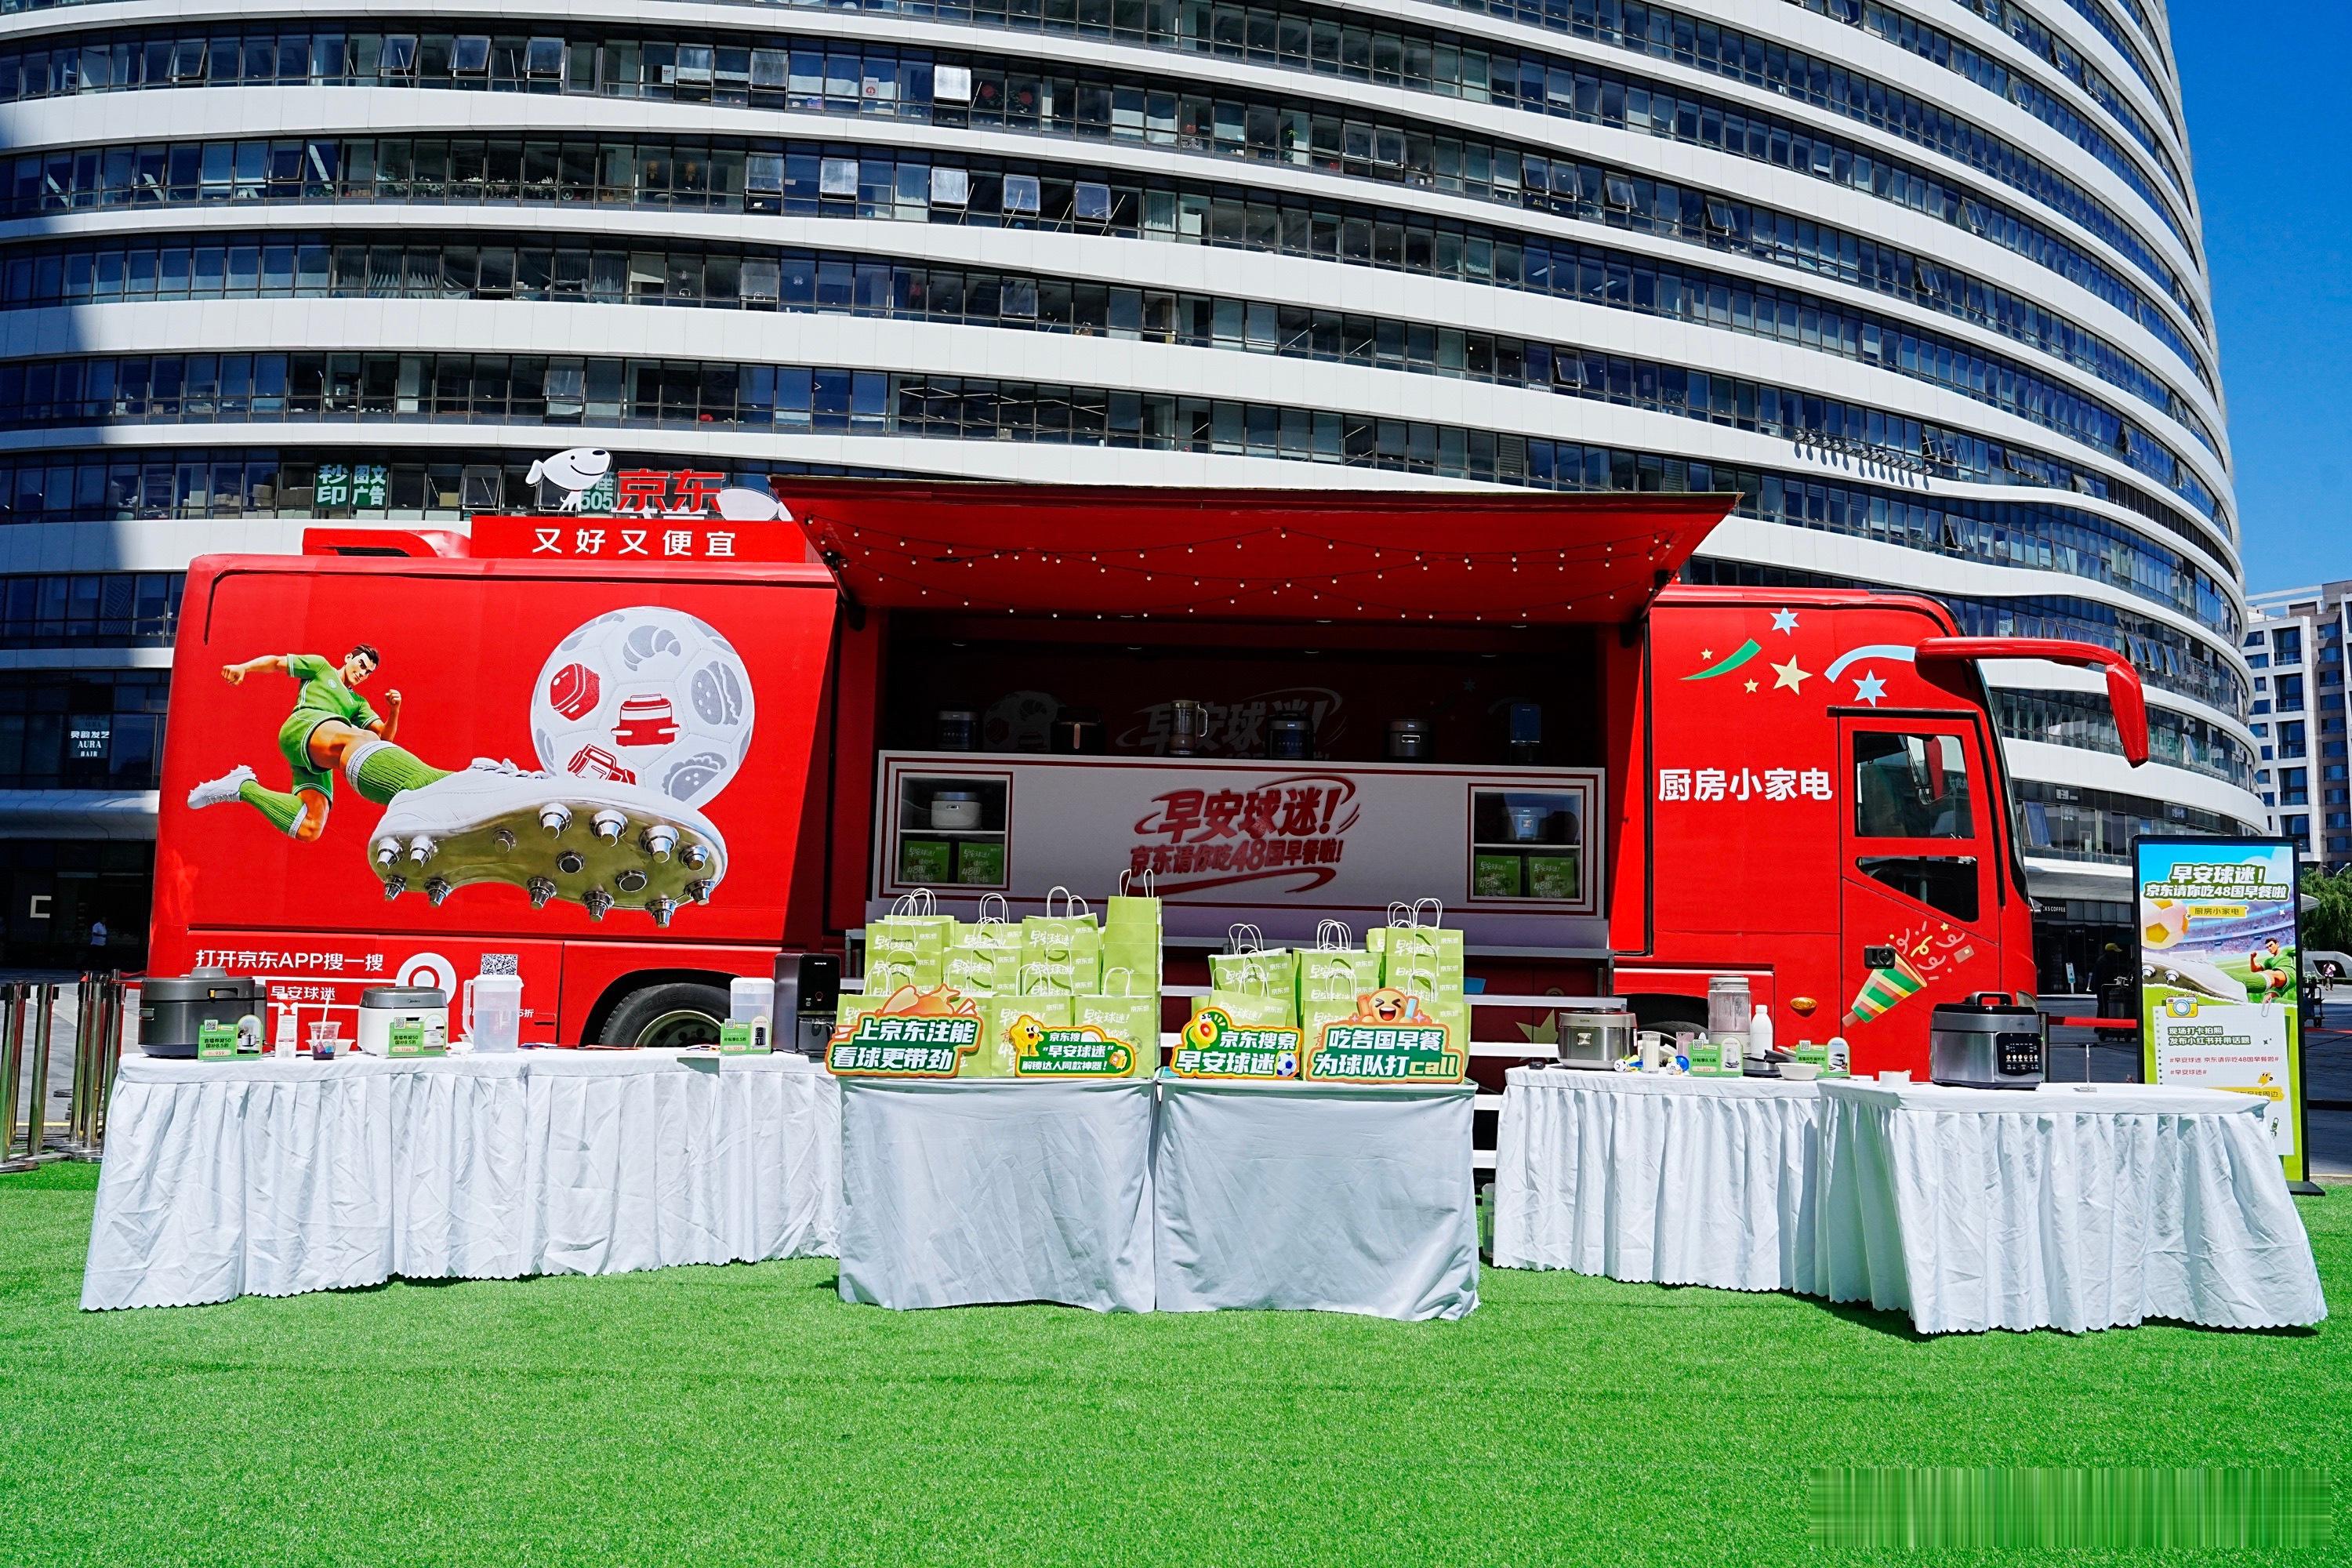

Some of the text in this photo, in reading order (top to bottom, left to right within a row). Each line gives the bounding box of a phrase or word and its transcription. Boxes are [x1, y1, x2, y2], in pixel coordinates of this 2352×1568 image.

[353, 464, 387, 485] 图文
[352, 485, 386, 506] 广告
[581, 492, 613, 510] 505
[616, 468, 726, 514] 京东
[532, 528, 735, 557] 又好又便宜
[77, 740, 102, 749] AURA
[1657, 768, 1834, 801] 厨房小家电
[1151, 787, 1342, 844] 早安球迷!
[1129, 839, 1344, 878] 京东请你吃48国早餐啦!
[2171, 865, 2264, 884] 早安球迷!
[2146, 884, 2286, 898] 京东请你吃48国早餐啦
[2194, 907, 2240, 916] 厨房小家电
[195, 949, 384, 972] 打开京东APP搜一搜
[270, 985, 336, 1000] 早安球迷
[855, 1019, 976, 1044] 上京东注能
[1049, 1033, 1081, 1042] 京东搜
[1220, 1030, 1298, 1051] 京东搜索
[1328, 1029, 1443, 1051] 吃各国早餐
[2168, 1026, 2223, 1036] 现场打卡拍照
[2169, 1036, 2251, 1046] 发布小红书并带话题
[833, 1046, 954, 1070] 看球更带劲
[1022, 1060, 1108, 1071] 解锁达人同款神器!
[1176, 1051, 1276, 1074] 早安球迷
[1314, 1054, 1457, 1076] 为球队打call
